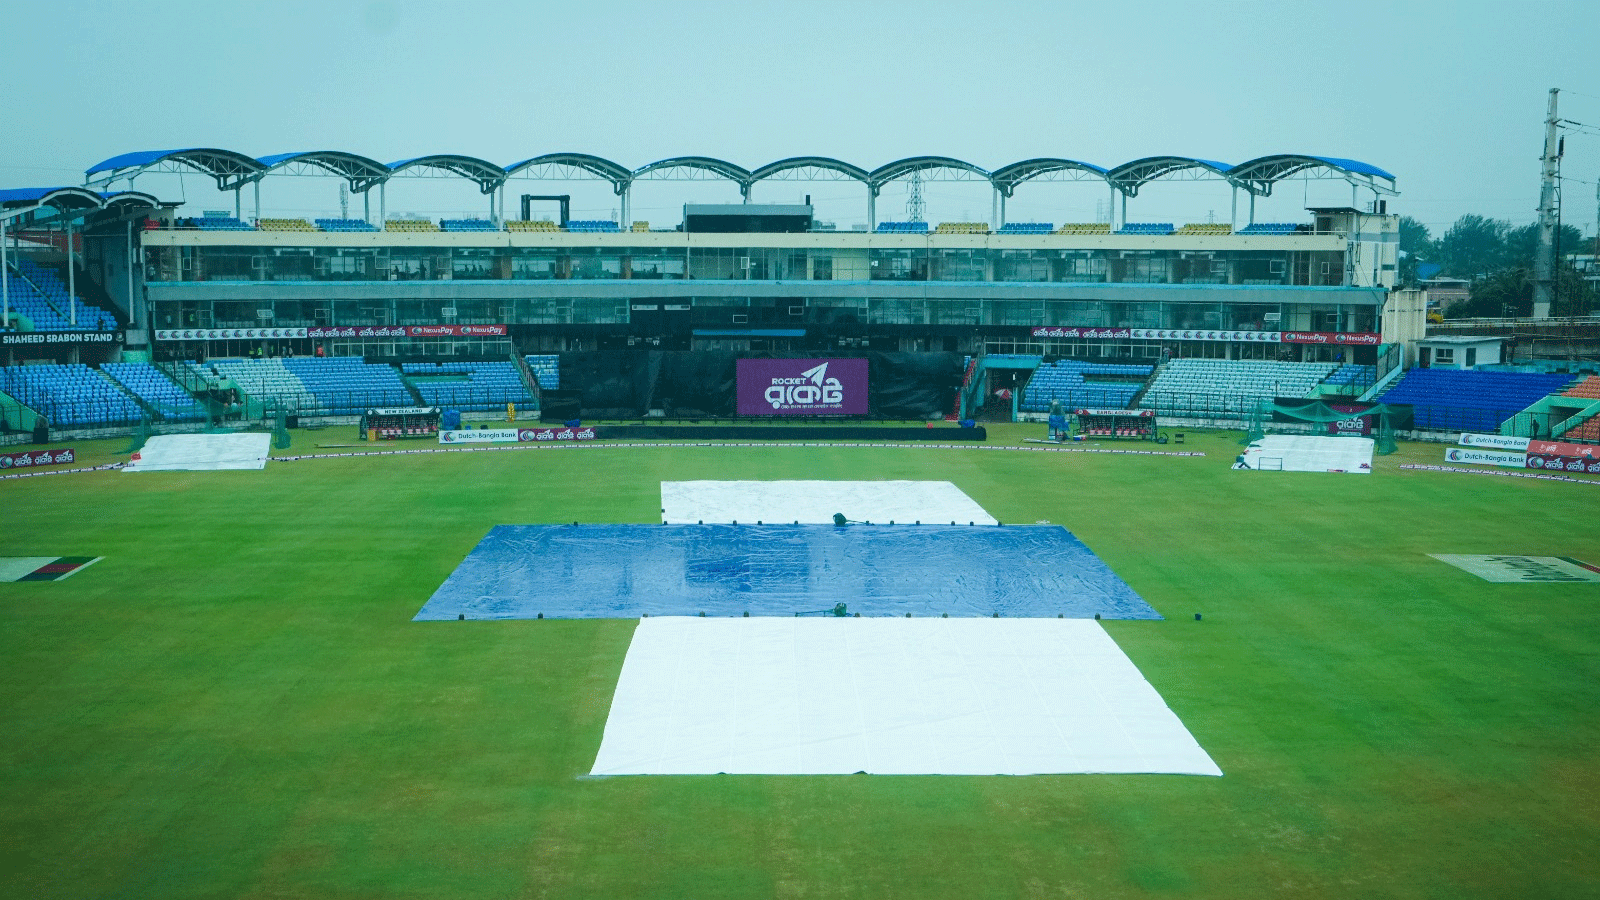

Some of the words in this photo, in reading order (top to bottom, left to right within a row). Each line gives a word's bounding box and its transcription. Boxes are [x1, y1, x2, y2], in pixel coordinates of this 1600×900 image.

[3, 335, 44, 343] SHAHEED
[47, 334, 82, 342] SRABON
[765, 378, 843, 409] রকেট
[1476, 438, 1512, 446] Dutch-Bangla
[1464, 453, 1506, 462] Dutch-Bangla
